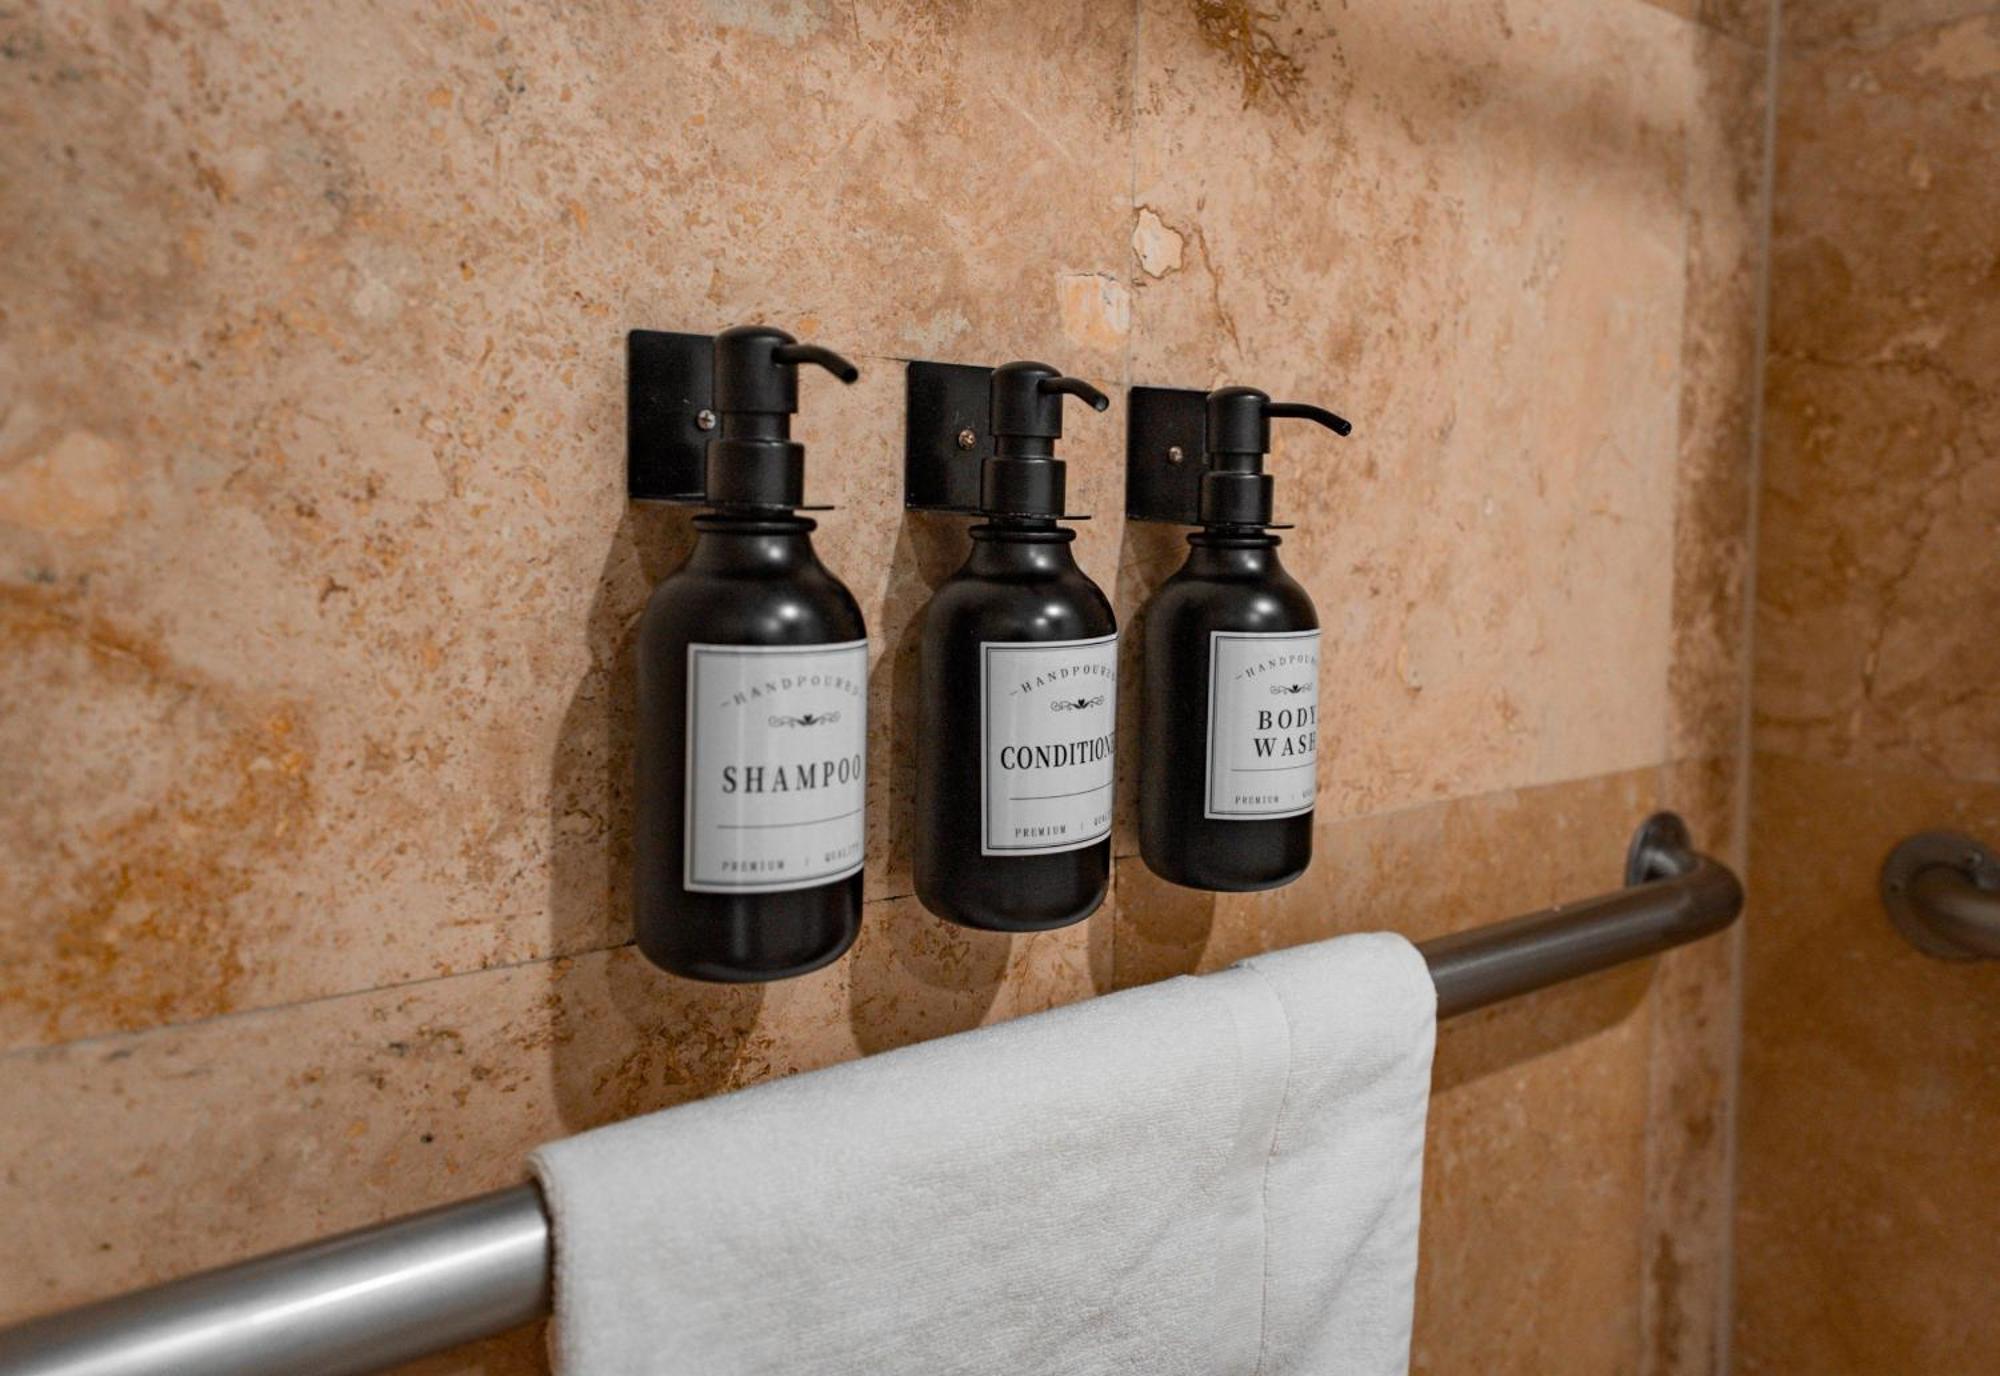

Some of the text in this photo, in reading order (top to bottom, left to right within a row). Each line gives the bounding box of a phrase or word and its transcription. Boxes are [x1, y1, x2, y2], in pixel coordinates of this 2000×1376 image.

[1258, 705, 1316, 732] BODY
[721, 753, 862, 794] SHAMPOO
[1235, 794, 1279, 805] PREMIUM
[1015, 824, 1067, 838] PREMIUM
[721, 860, 785, 873] PREMIUM
